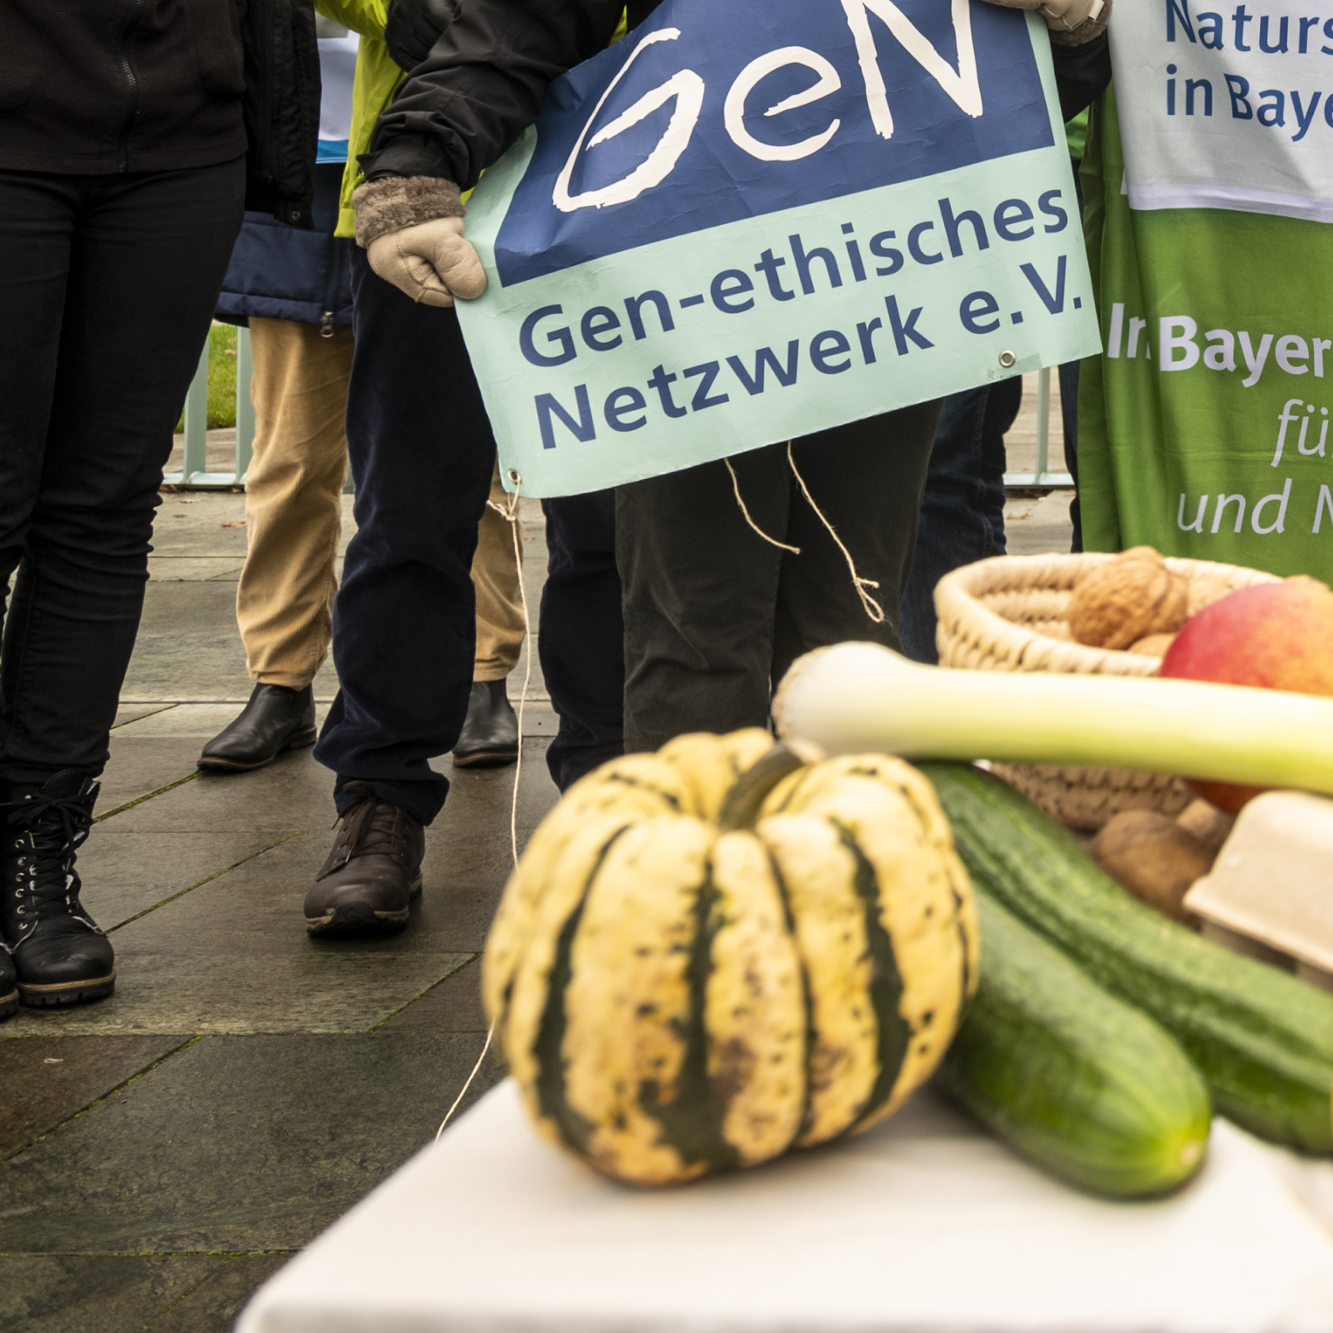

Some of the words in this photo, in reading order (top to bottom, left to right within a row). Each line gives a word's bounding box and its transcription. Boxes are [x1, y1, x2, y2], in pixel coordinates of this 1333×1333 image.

[1165, 64, 1213, 118] in
[519, 189, 1069, 367] Gen-ethisches
[534, 294, 935, 450] Netzwerk
[959, 255, 1083, 335] e.V.
[1176, 478, 1292, 536] und
